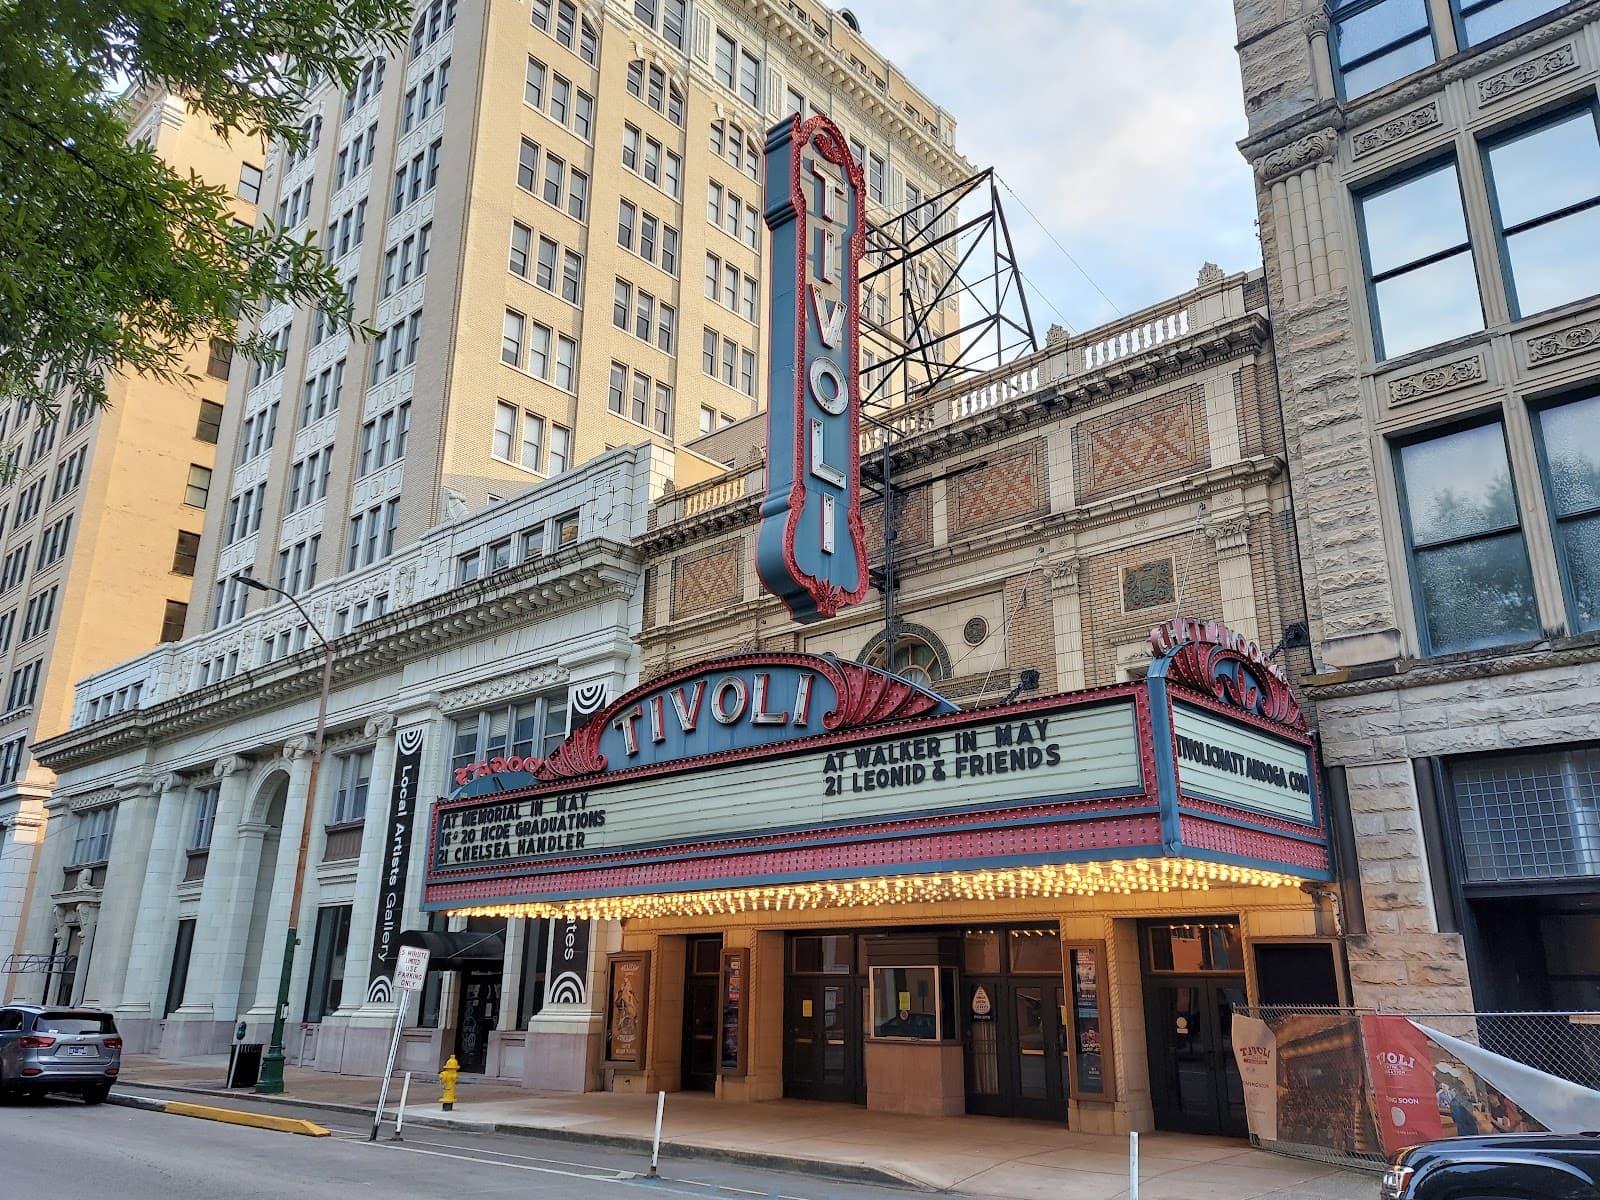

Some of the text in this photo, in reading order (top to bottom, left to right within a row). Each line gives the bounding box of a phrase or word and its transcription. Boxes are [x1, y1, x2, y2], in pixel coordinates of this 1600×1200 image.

[809, 159, 849, 555] TIVOLI
[612, 673, 815, 757] TIVOLI
[823, 719, 1049, 774] AT WALKER IN MAY
[824, 744, 1061, 796] 21 LEONID & FRIENDS
[443, 792, 589, 830] AT MEMORIAL IN MAY
[481, 824, 510, 842] HCDE
[515, 810, 606, 837] GRADUATIONS
[378, 765, 412, 962] Local Artists Gallery
[438, 832, 586, 864] 21 CHELSEA HANDLER
[1398, 1097, 1420, 1105] SOON
